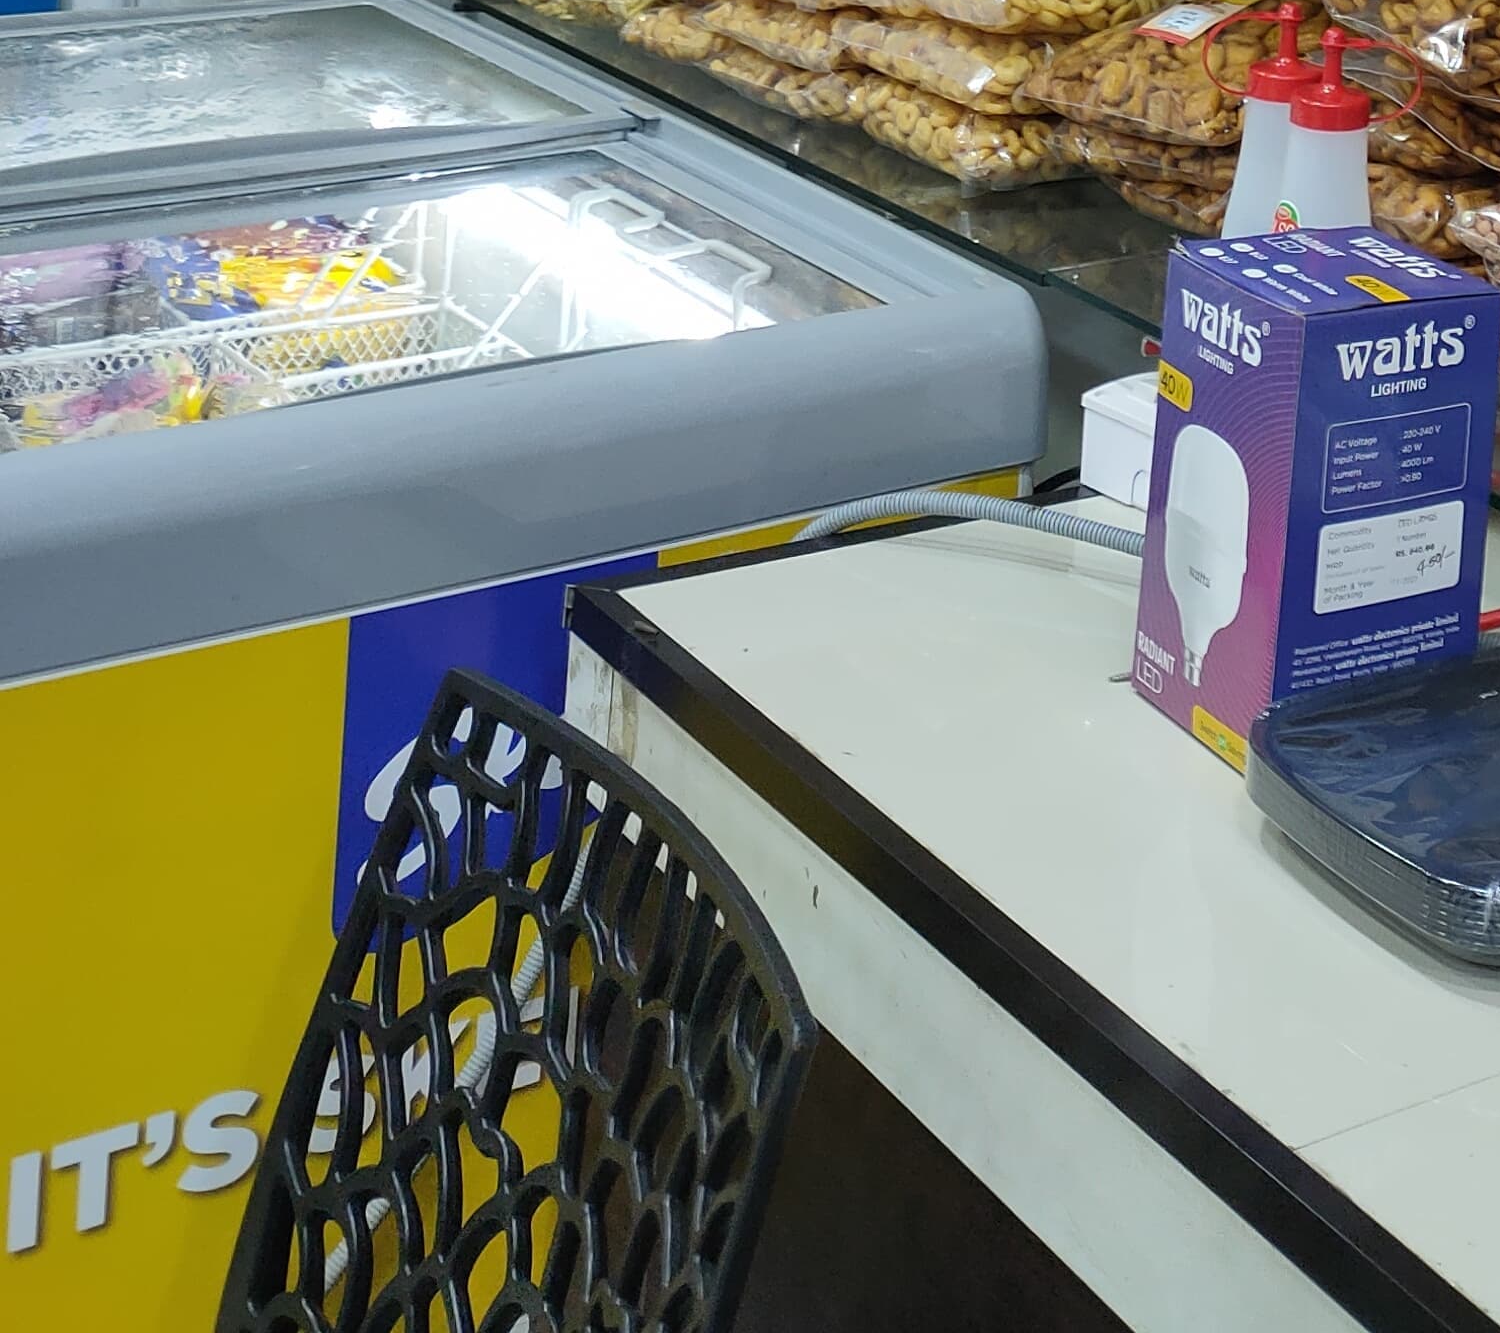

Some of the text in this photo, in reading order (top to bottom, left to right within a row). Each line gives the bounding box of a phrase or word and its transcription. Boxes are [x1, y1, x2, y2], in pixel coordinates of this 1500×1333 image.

[1262, 236, 1308, 255] LED
[1348, 236, 1448, 279] watts
[1181, 288, 1263, 368] watts
[1198, 344, 1235, 376] LIGHTING
[1336, 320, 1466, 382] watts
[1370, 377, 1428, 398] LIGHTING
[1333, 454, 1353, 466] Input
[1354, 451, 1380, 462] Power
[1347, 436, 1378, 449] Voltage
[1330, 484, 1356, 496] Power
[1357, 480, 1383, 491] Factor
[1332, 468, 1362, 480] Lumens
[1137, 630, 1176, 676] RADIANT
[1136, 655, 1164, 694] LED
[7, 1089, 260, 1254] IT'S
